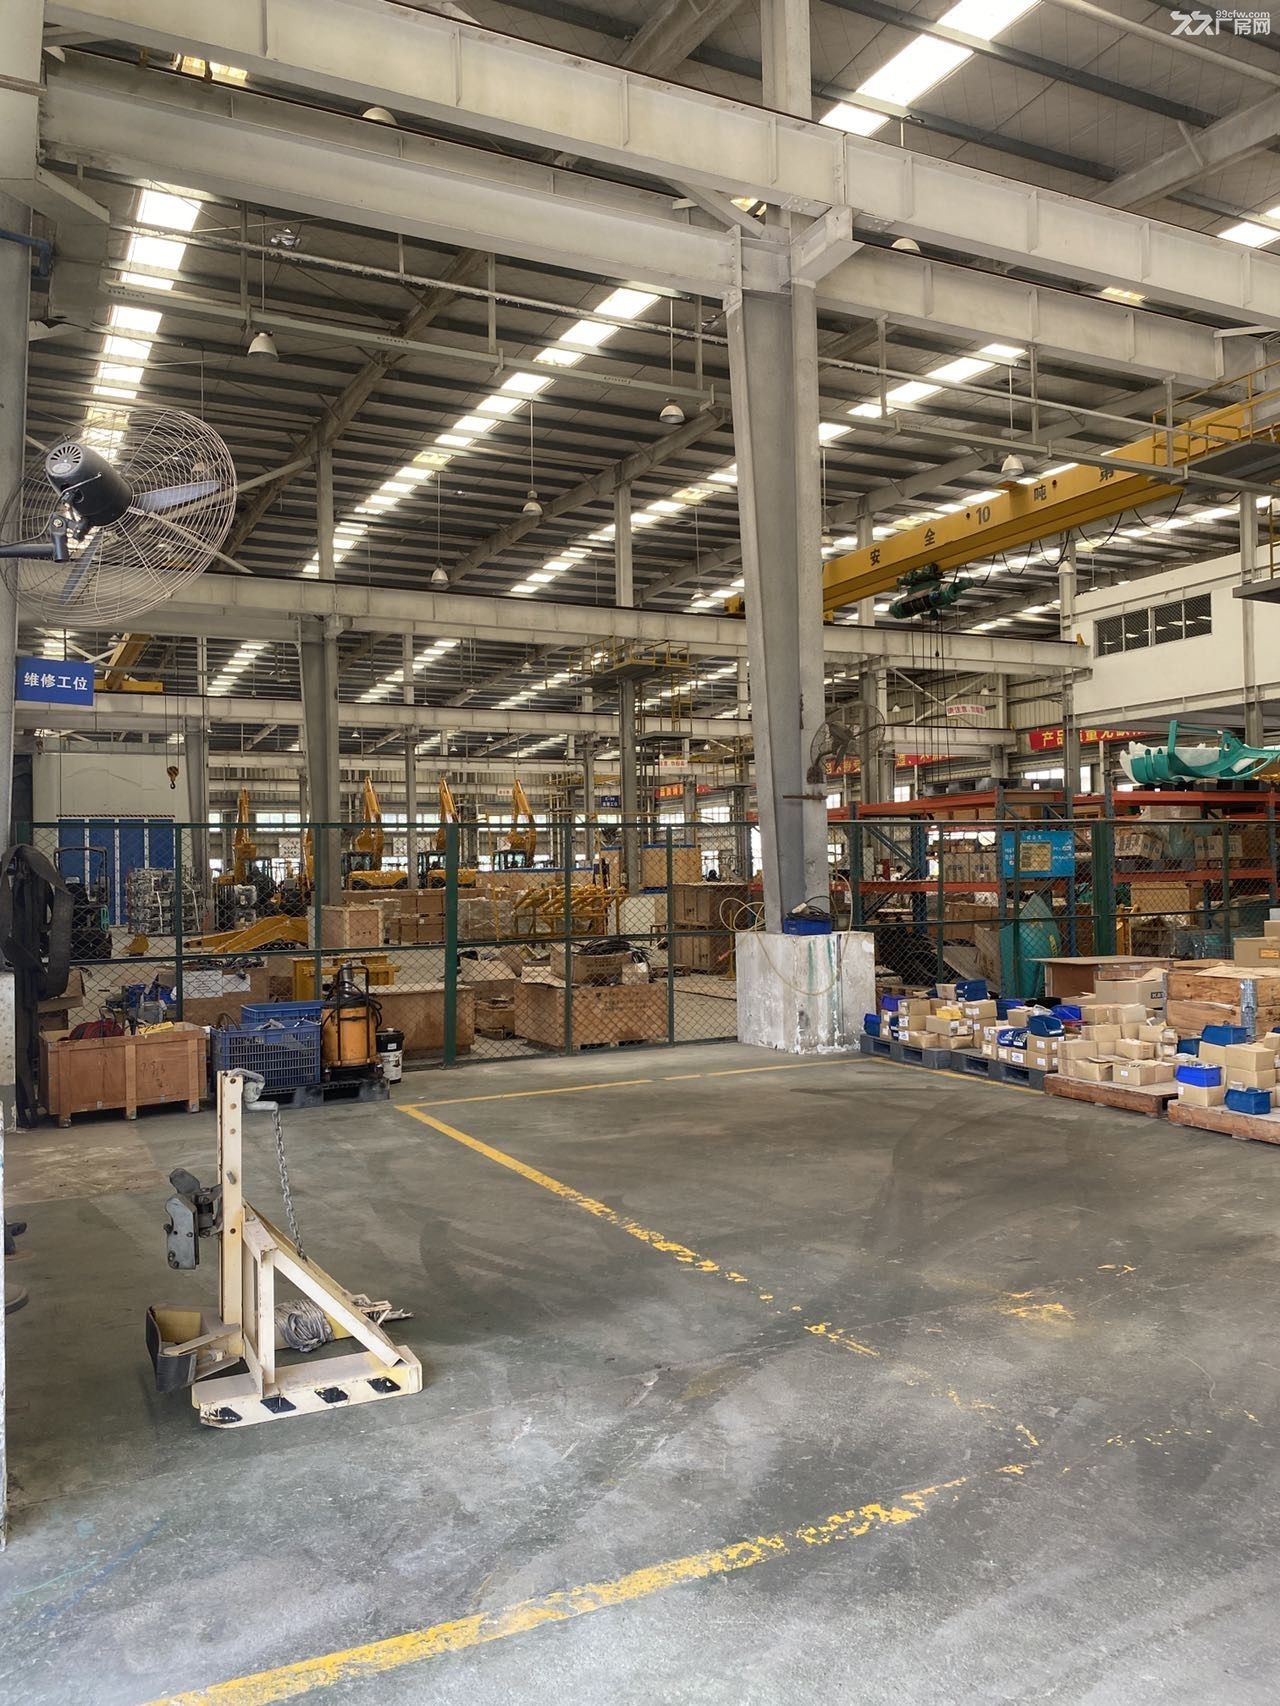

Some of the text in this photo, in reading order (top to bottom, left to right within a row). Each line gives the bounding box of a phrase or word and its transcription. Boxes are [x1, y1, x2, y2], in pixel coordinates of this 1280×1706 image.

[975, 505, 991, 526] 10
[1033, 484, 1047, 501] 吨
[24, 671, 88, 691] 维修工位
